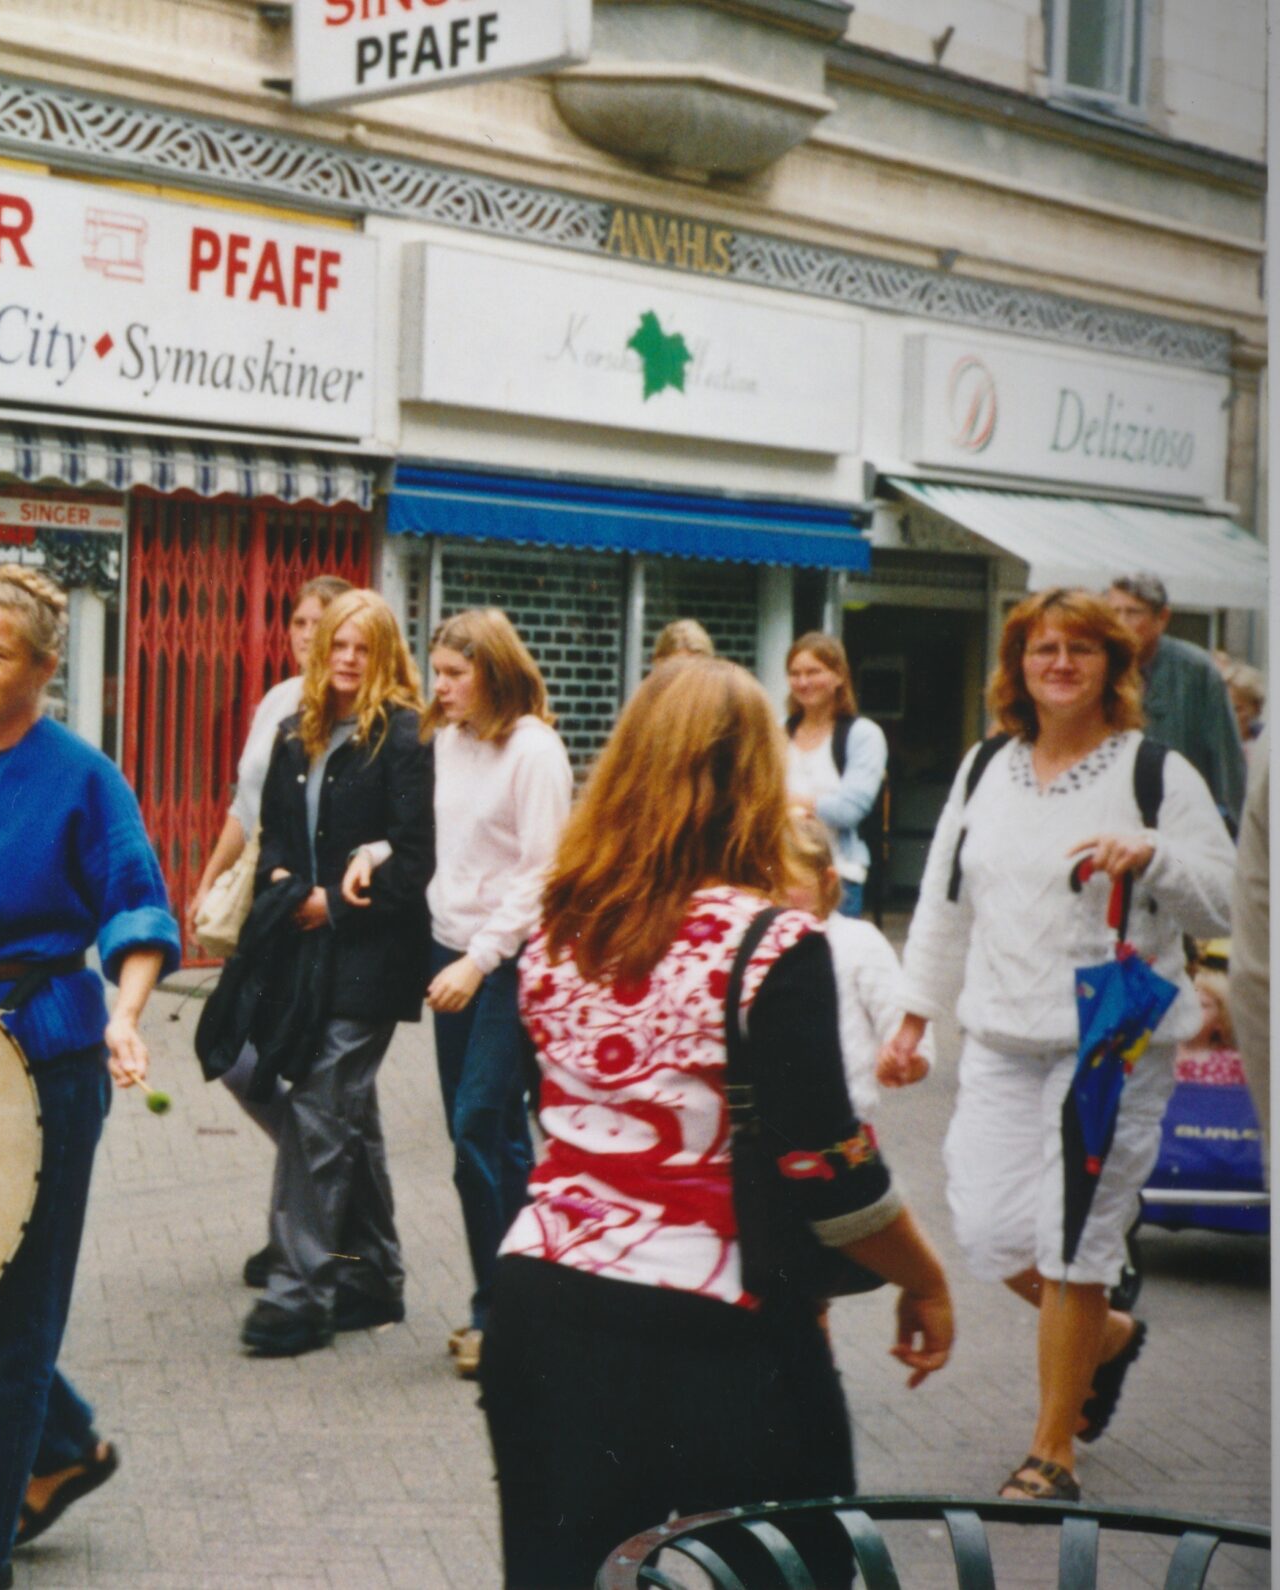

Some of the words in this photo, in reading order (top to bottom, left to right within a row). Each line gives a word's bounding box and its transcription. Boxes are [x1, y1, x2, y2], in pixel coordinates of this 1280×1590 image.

[355, 12, 499, 85] PFAFF
[189, 227, 342, 312] PFAFF
[119, 321, 365, 404] Symaskiner
[1049, 387, 1197, 470] Delizioso
[20, 502, 91, 526] SINGER
